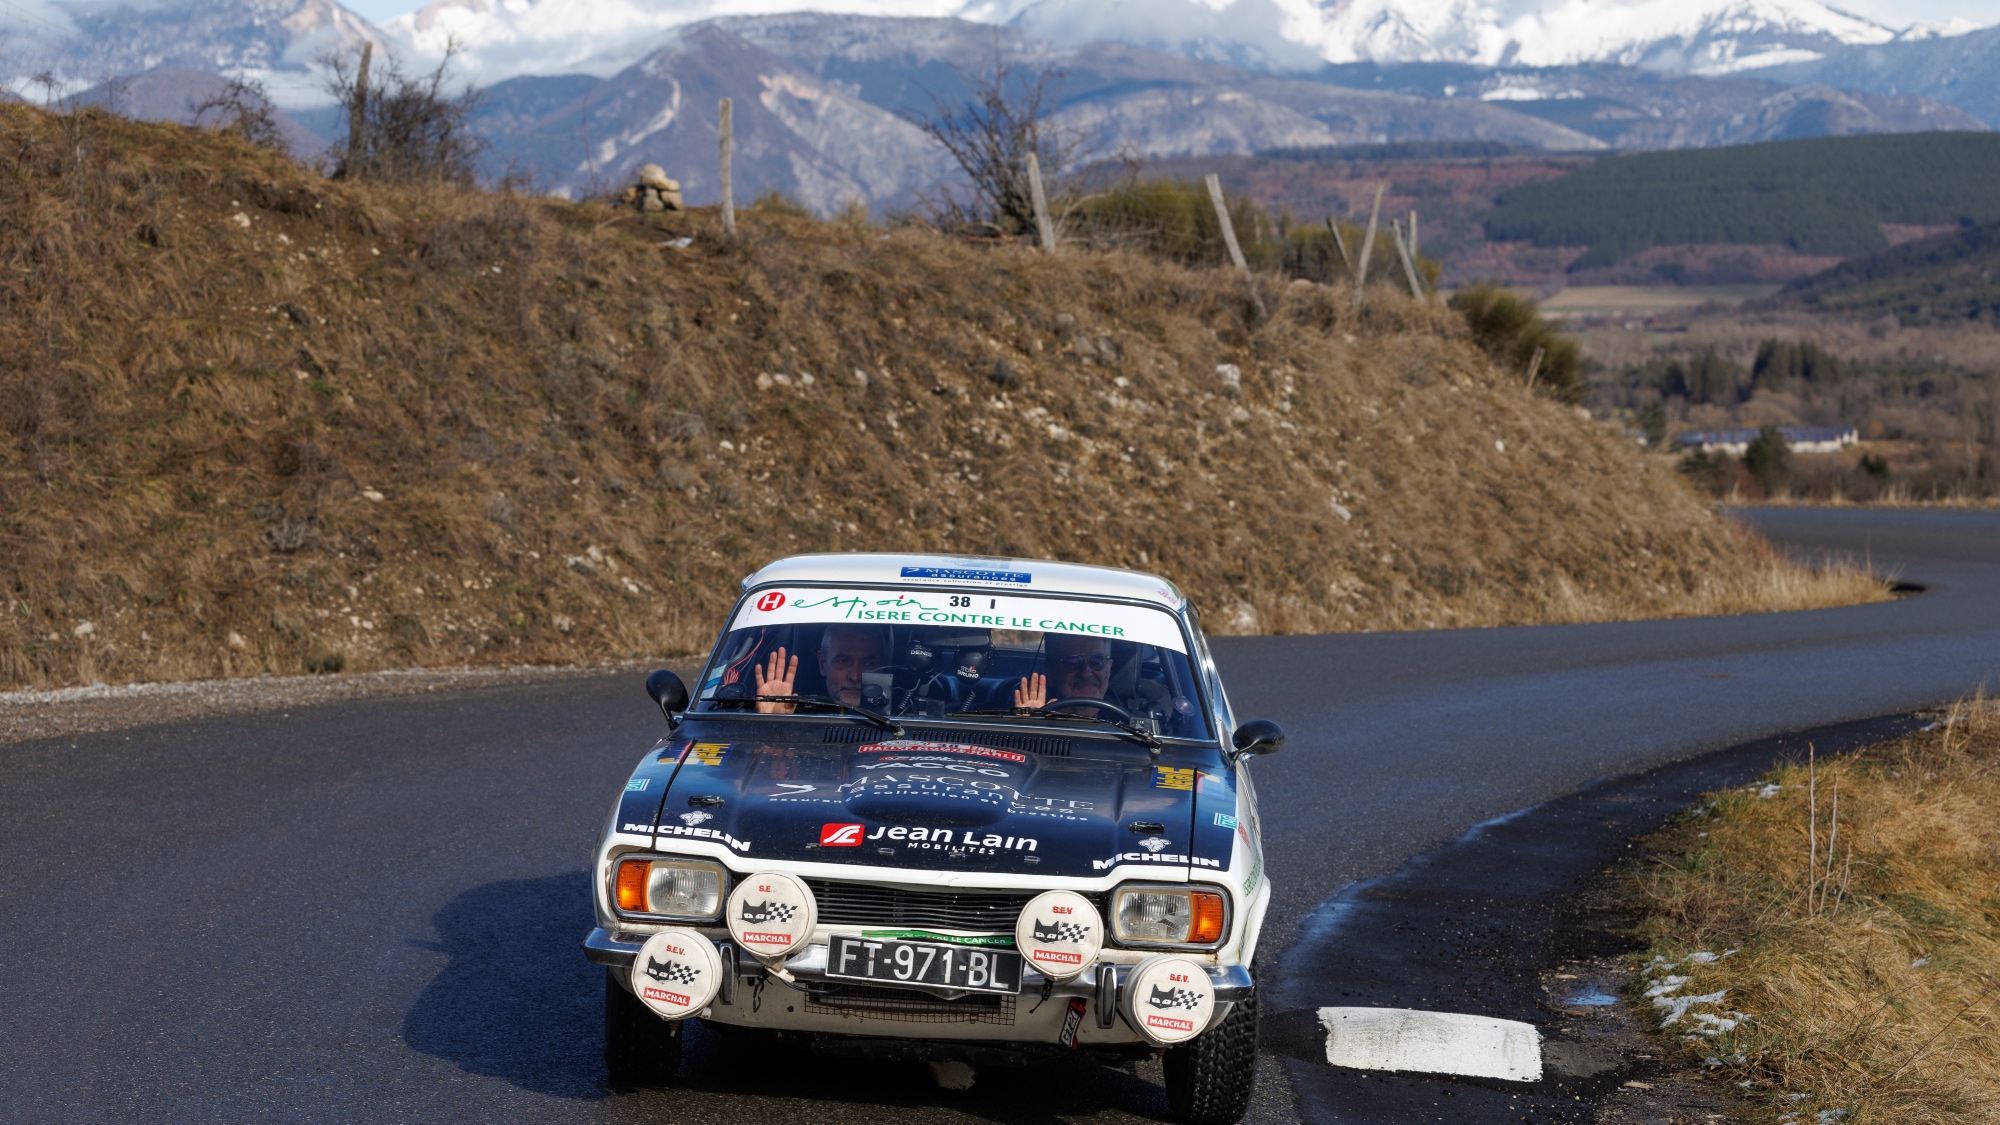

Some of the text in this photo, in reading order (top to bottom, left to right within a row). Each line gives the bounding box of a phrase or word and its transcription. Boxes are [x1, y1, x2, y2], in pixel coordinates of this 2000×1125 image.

[925, 569, 1024, 578] MASCOTTE
[931, 573, 1017, 582] assurances
[790, 594, 939, 619] espoir
[949, 596, 971, 608] 38
[858, 610, 1125, 637] ISERE CONTRE LE CANCER
[910, 649, 932, 658] DENIS
[957, 669, 979, 679] BRUNO
[855, 762, 1010, 778] YACCO
[835, 774, 1094, 811] MASCOTTE
[873, 790, 970, 800] collection
[980, 798, 999, 806] et
[1007, 807, 1089, 821] prestige
[623, 823, 751, 852] MICHELIN
[866, 825, 1038, 852] Jean Lain
[1092, 852, 1220, 870] MICHELIN
[745, 934, 790, 944] MARCHAL
[665, 944, 686, 956] S.E.V.
[1035, 950, 1080, 963] MARCHAL
[838, 939, 1010, 990] FT-971-BL
[1169, 972, 1190, 983] S.E.V.
[645, 989, 689, 1005] MARCHAL
[1149, 1016, 1192, 1030] MARCHAL
